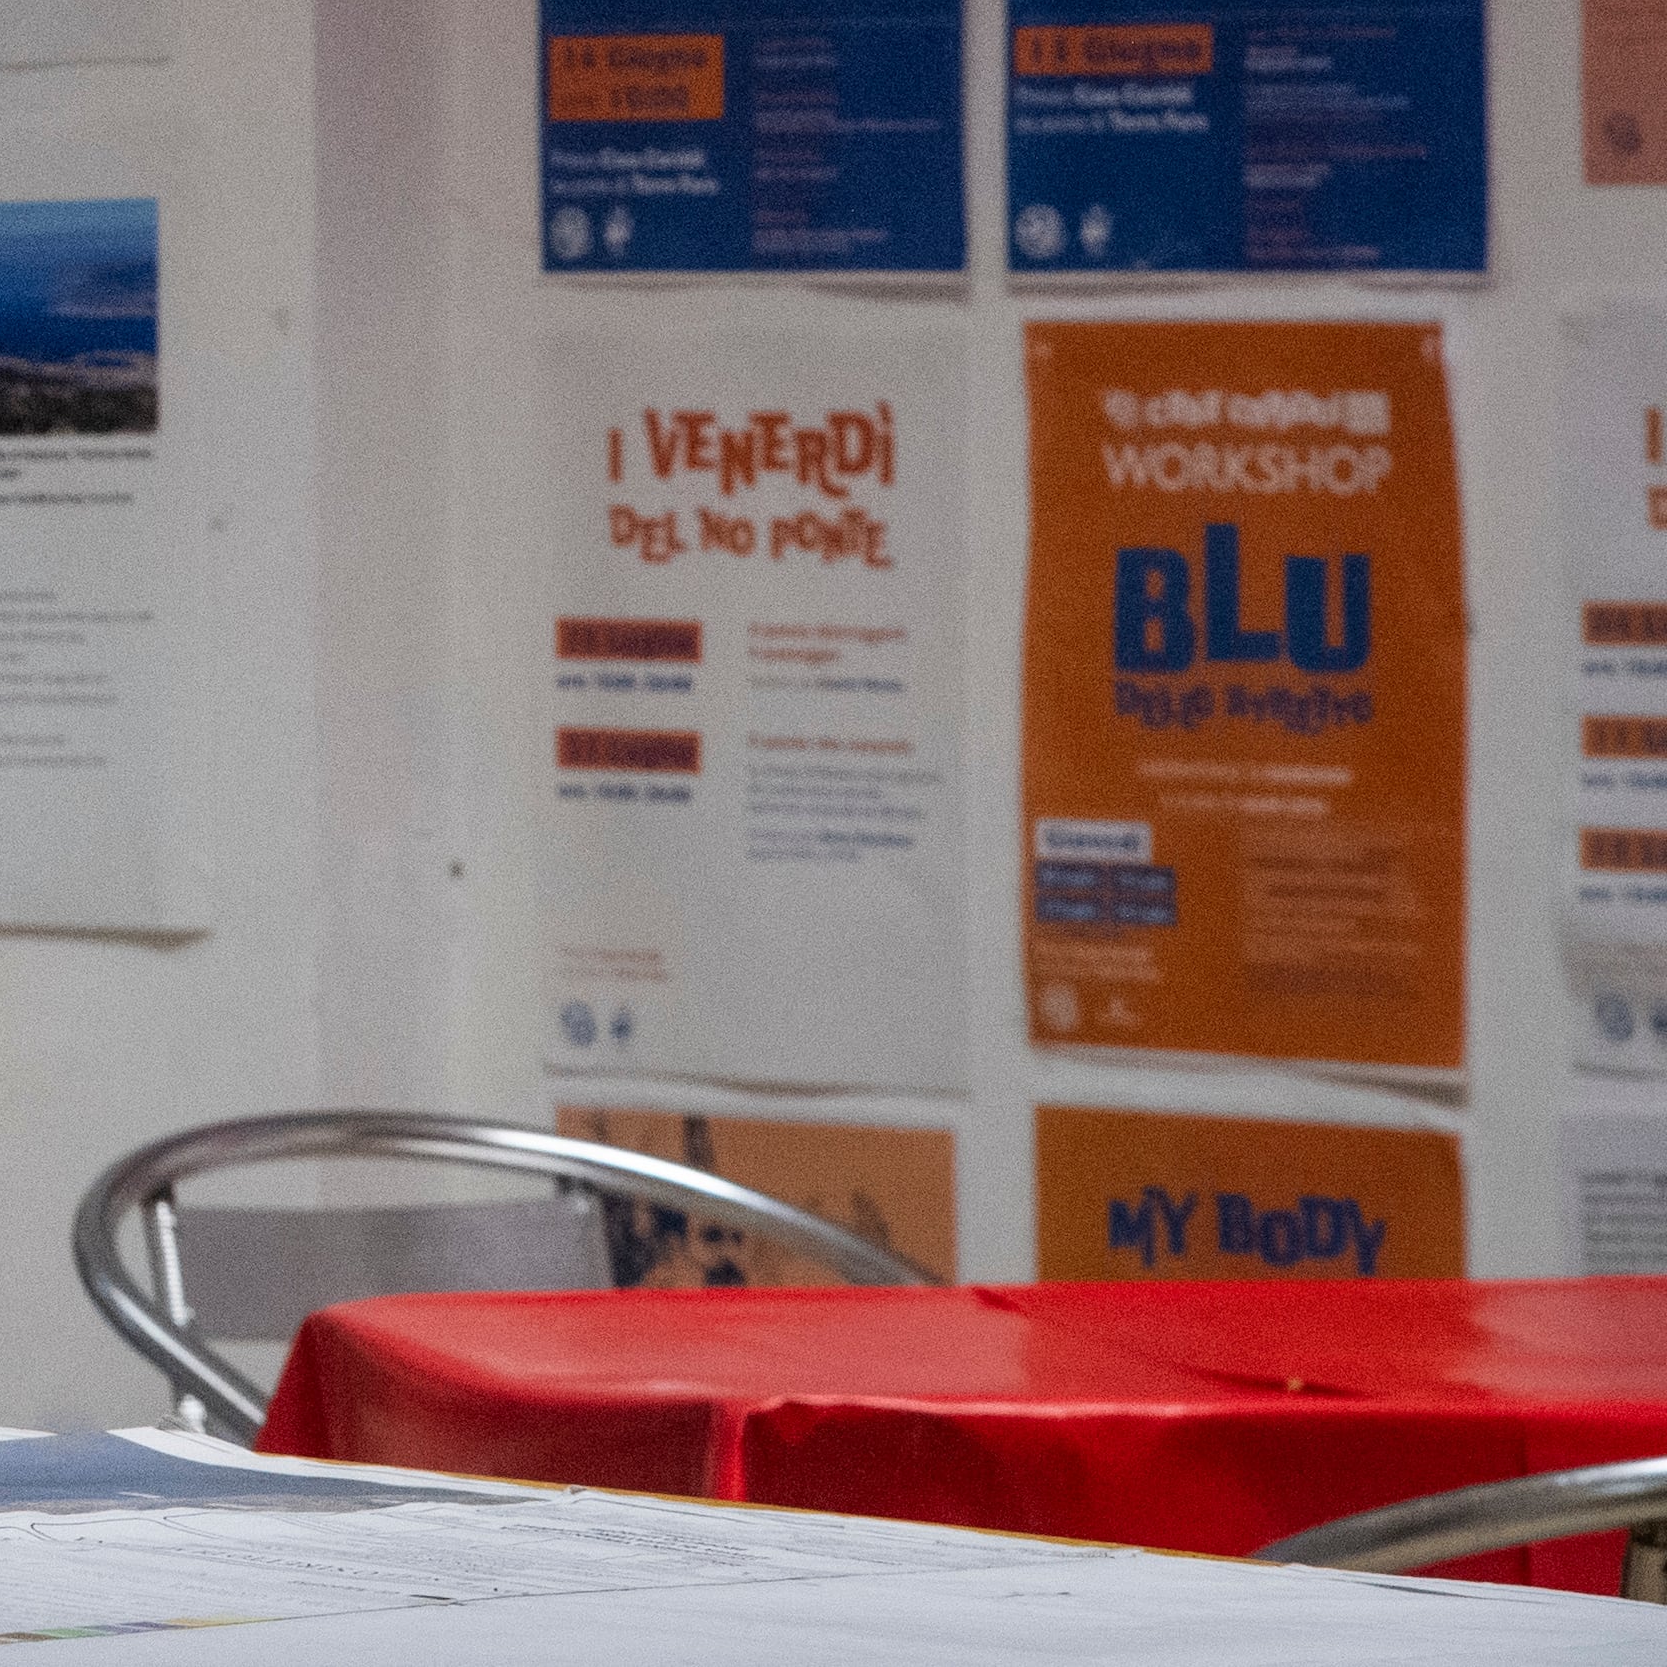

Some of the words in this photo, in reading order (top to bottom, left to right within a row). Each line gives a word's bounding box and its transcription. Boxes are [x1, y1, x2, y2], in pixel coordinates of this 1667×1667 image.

[607, 428, 622, 482] I
[643, 401, 895, 498] VENERDÌ
[1103, 442, 1393, 497] WORKSHOP
[610, 505, 687, 565] DEL
[698, 507, 756, 557] NO
[768, 507, 894, 569] PONTE
[1115, 523, 1373, 674] BLU
[1107, 1182, 1198, 1268] MY
[1216, 1191, 1388, 1276] BODY
